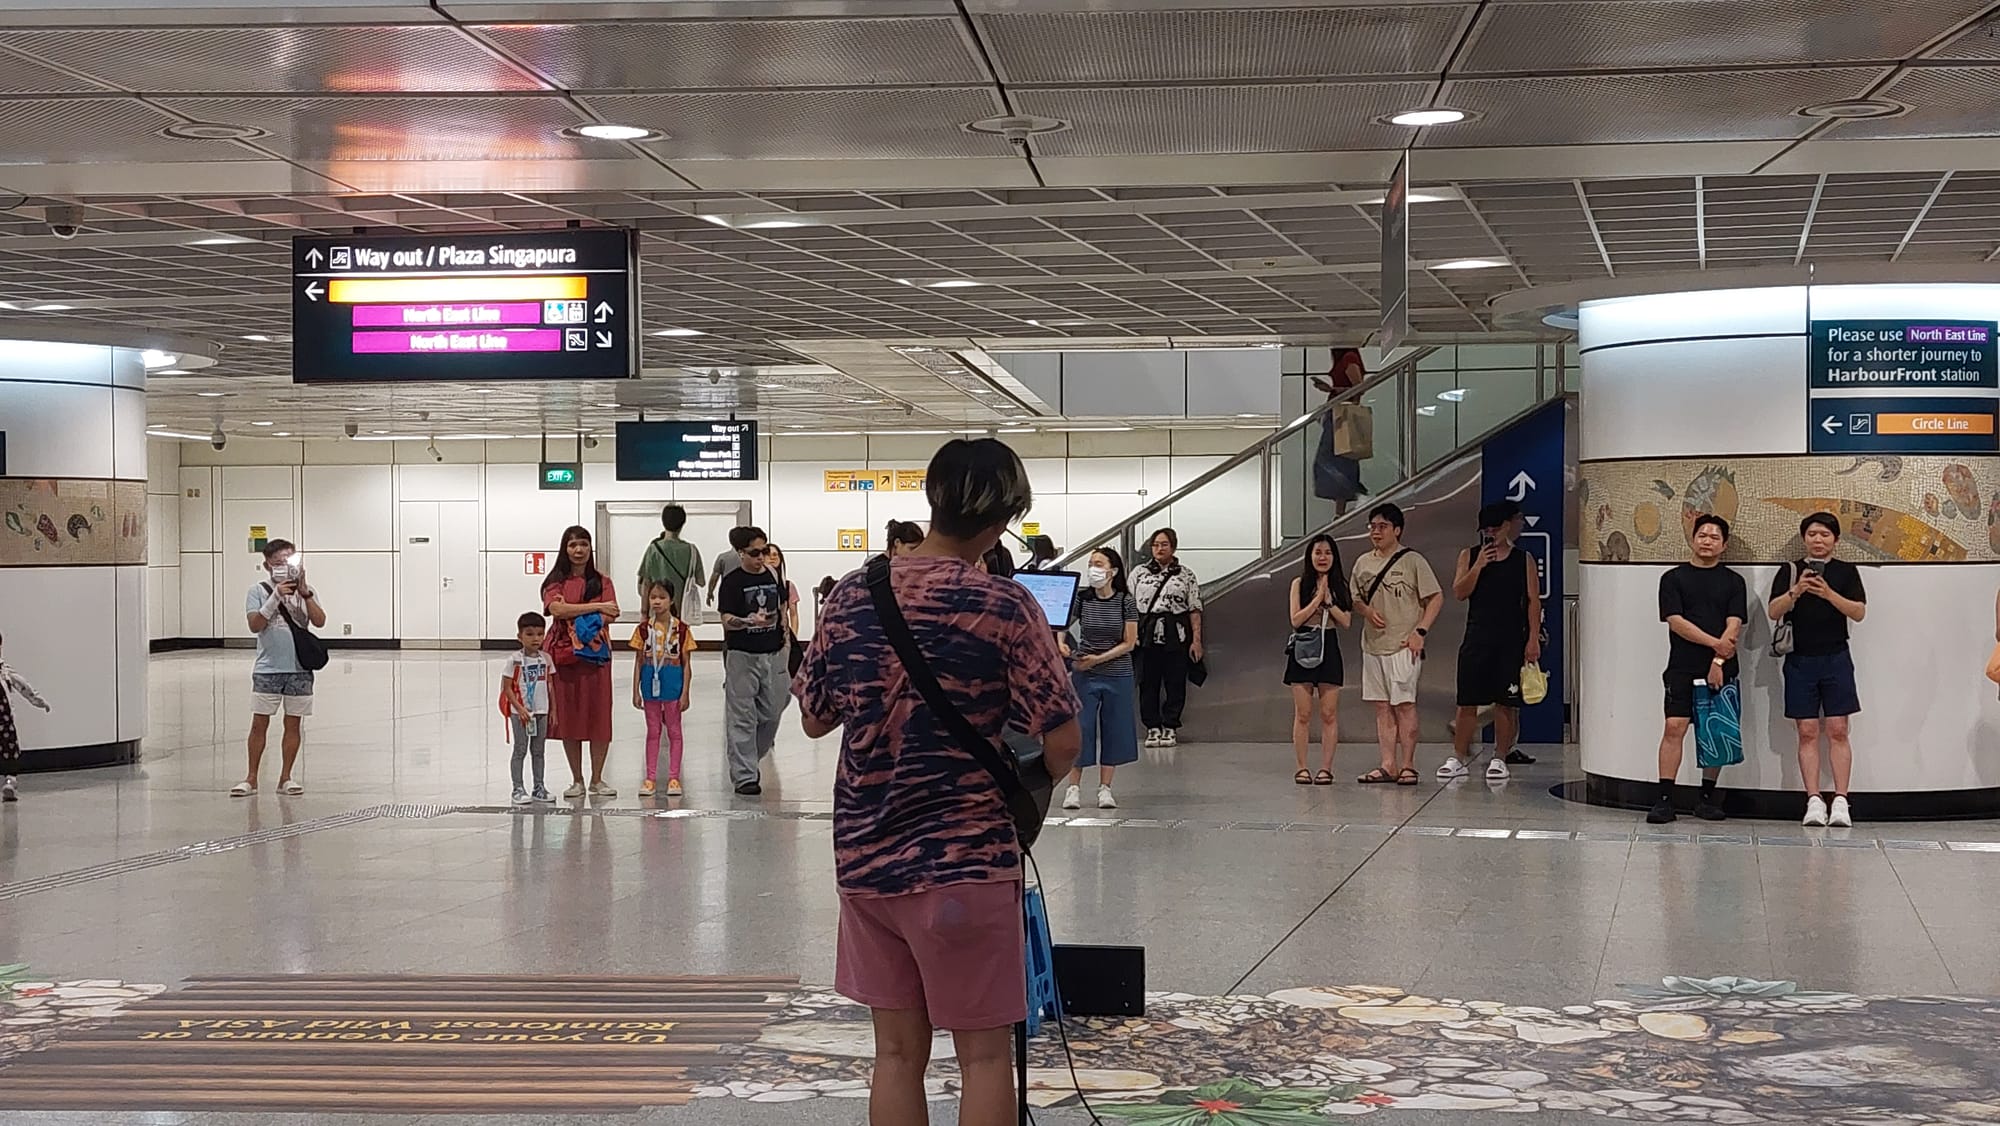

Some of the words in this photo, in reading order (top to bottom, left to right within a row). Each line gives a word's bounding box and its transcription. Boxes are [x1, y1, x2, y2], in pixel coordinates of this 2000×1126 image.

[355, 249, 389, 270] Way
[393, 250, 423, 266] out
[425, 250, 434, 267] /
[438, 246, 485, 265] Plaza
[489, 244, 576, 268] Singapura
[403, 308, 441, 322] North
[443, 307, 470, 322] East
[472, 307, 500, 321] Line
[1828, 327, 1875, 342] Please
[1879, 330, 1903, 342] use
[1910, 328, 1942, 341] North
[1945, 329, 1966, 341] East
[1968, 330, 1986, 342] Line
[410, 334, 448, 349] North
[450, 334, 477, 349] East
[479, 333, 507, 348] Line
[1827, 347, 1849, 362] for
[1853, 350, 1862, 362] a
[1866, 347, 1917, 362] shorter
[1920, 347, 1968, 364] journey
[1971, 349, 1982, 362] to
[1828, 367, 1937, 382] HarbourFront
[1940, 368, 1980, 382] station
[712, 425, 726, 433] Way
[1912, 418, 1944, 430] Circle
[1947, 418, 1969, 430] Line
[547, 470, 564, 481] EXIT
[176, 1019, 300, 1029] ASIA
[303, 1020, 411, 1030] Wild
[428, 1020, 679, 1031] Rainforest
[138, 1031, 192, 1040] at
[206, 1031, 461, 1042] adventure
[473, 1031, 586, 1042] your
[603, 1031, 670, 1043] Up
